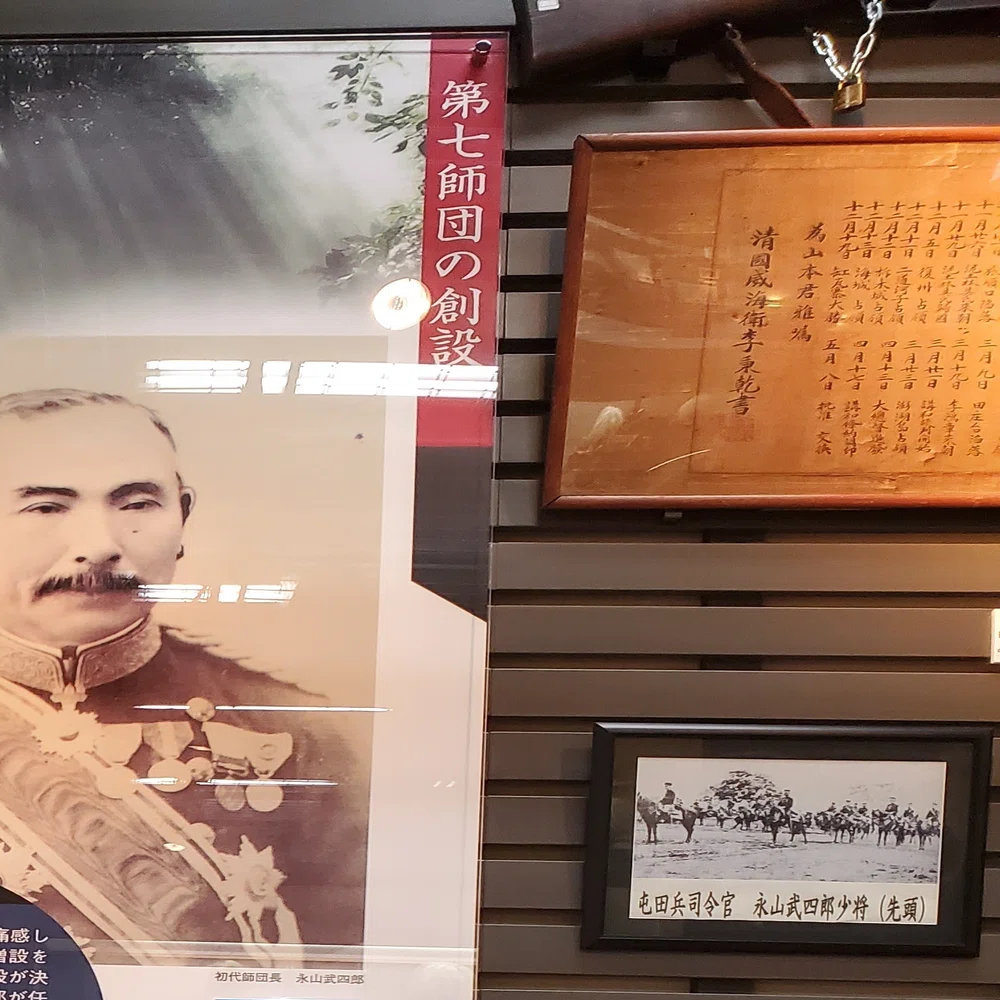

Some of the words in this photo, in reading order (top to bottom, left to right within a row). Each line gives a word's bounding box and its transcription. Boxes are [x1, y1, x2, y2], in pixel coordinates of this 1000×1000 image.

[429, 80, 490, 366] 第七師団の創設
[639, 891, 737, 919] 屯田兵司令官
[215, 971, 282, 983] 初代師団長
[296, 973, 364, 985] 永山武四郎
